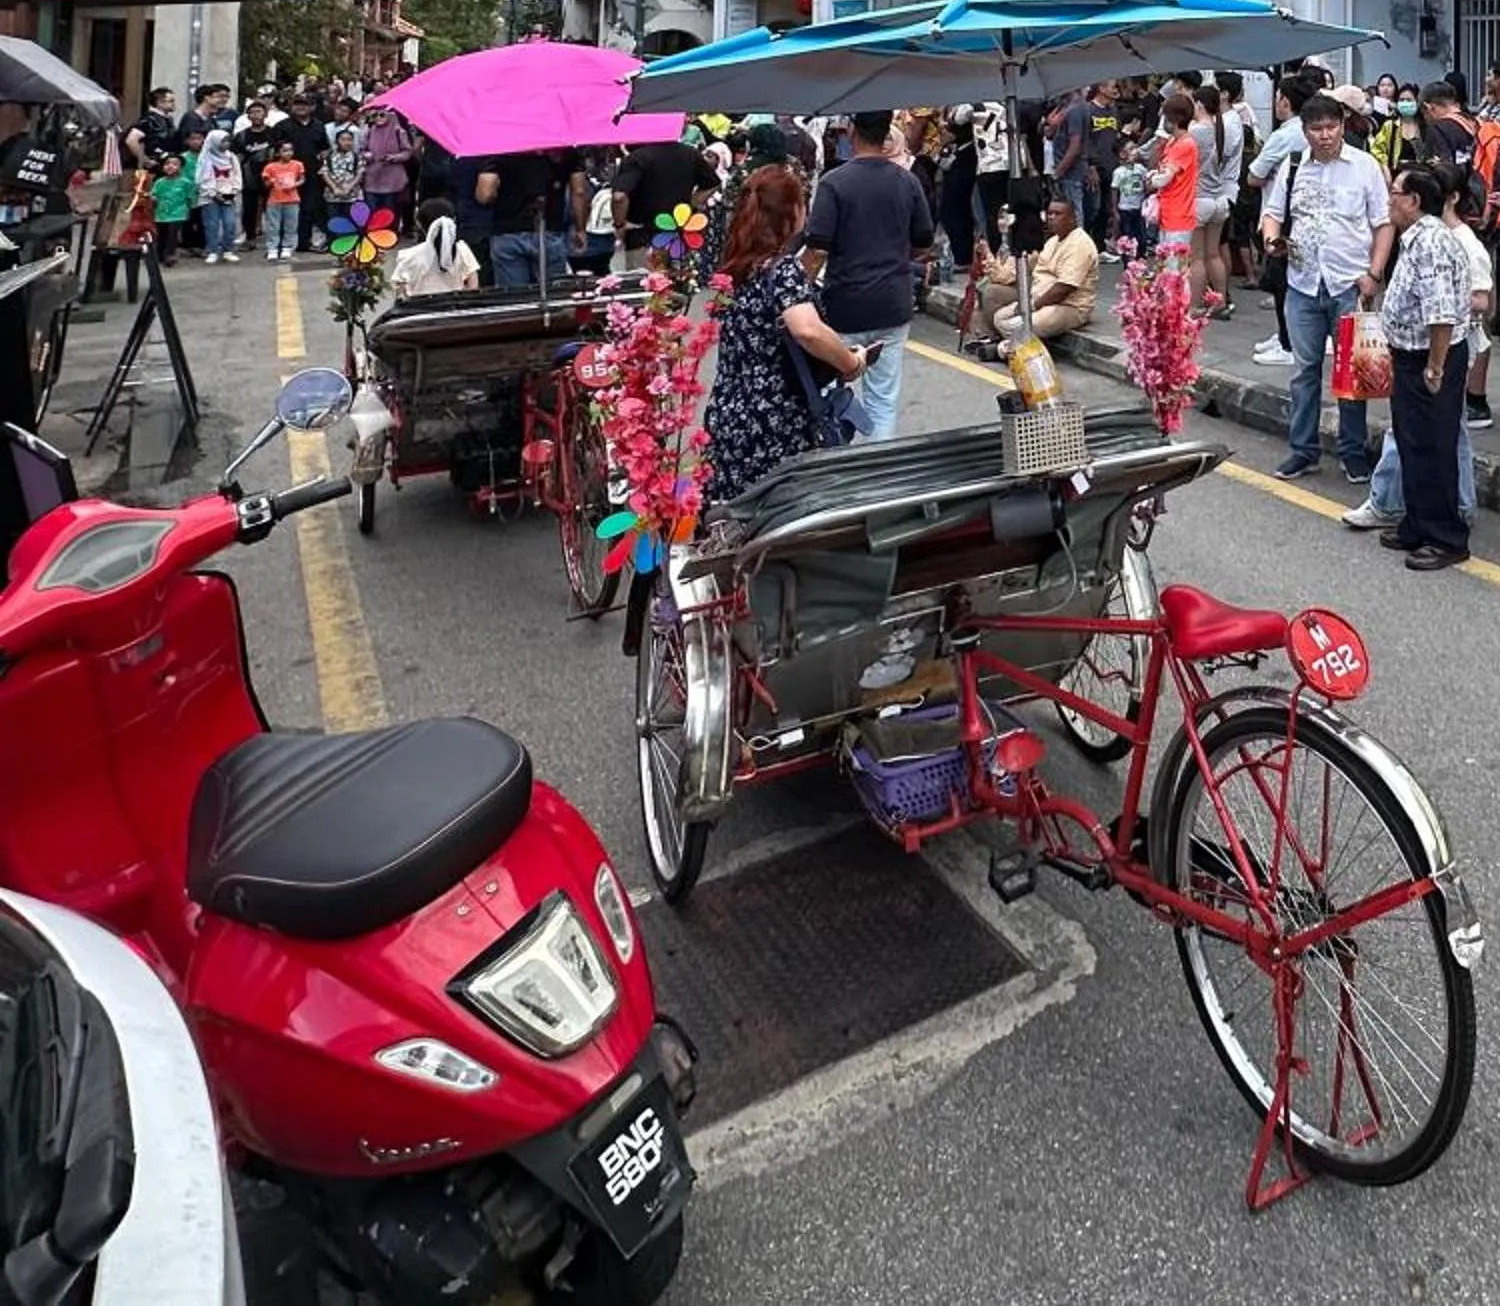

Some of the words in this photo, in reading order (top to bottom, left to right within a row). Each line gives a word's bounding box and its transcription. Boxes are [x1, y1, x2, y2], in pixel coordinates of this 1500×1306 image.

[22, 159, 45, 171] FOR
[1311, 643, 1361, 686] 792
[598, 1107, 661, 1180] BNC
